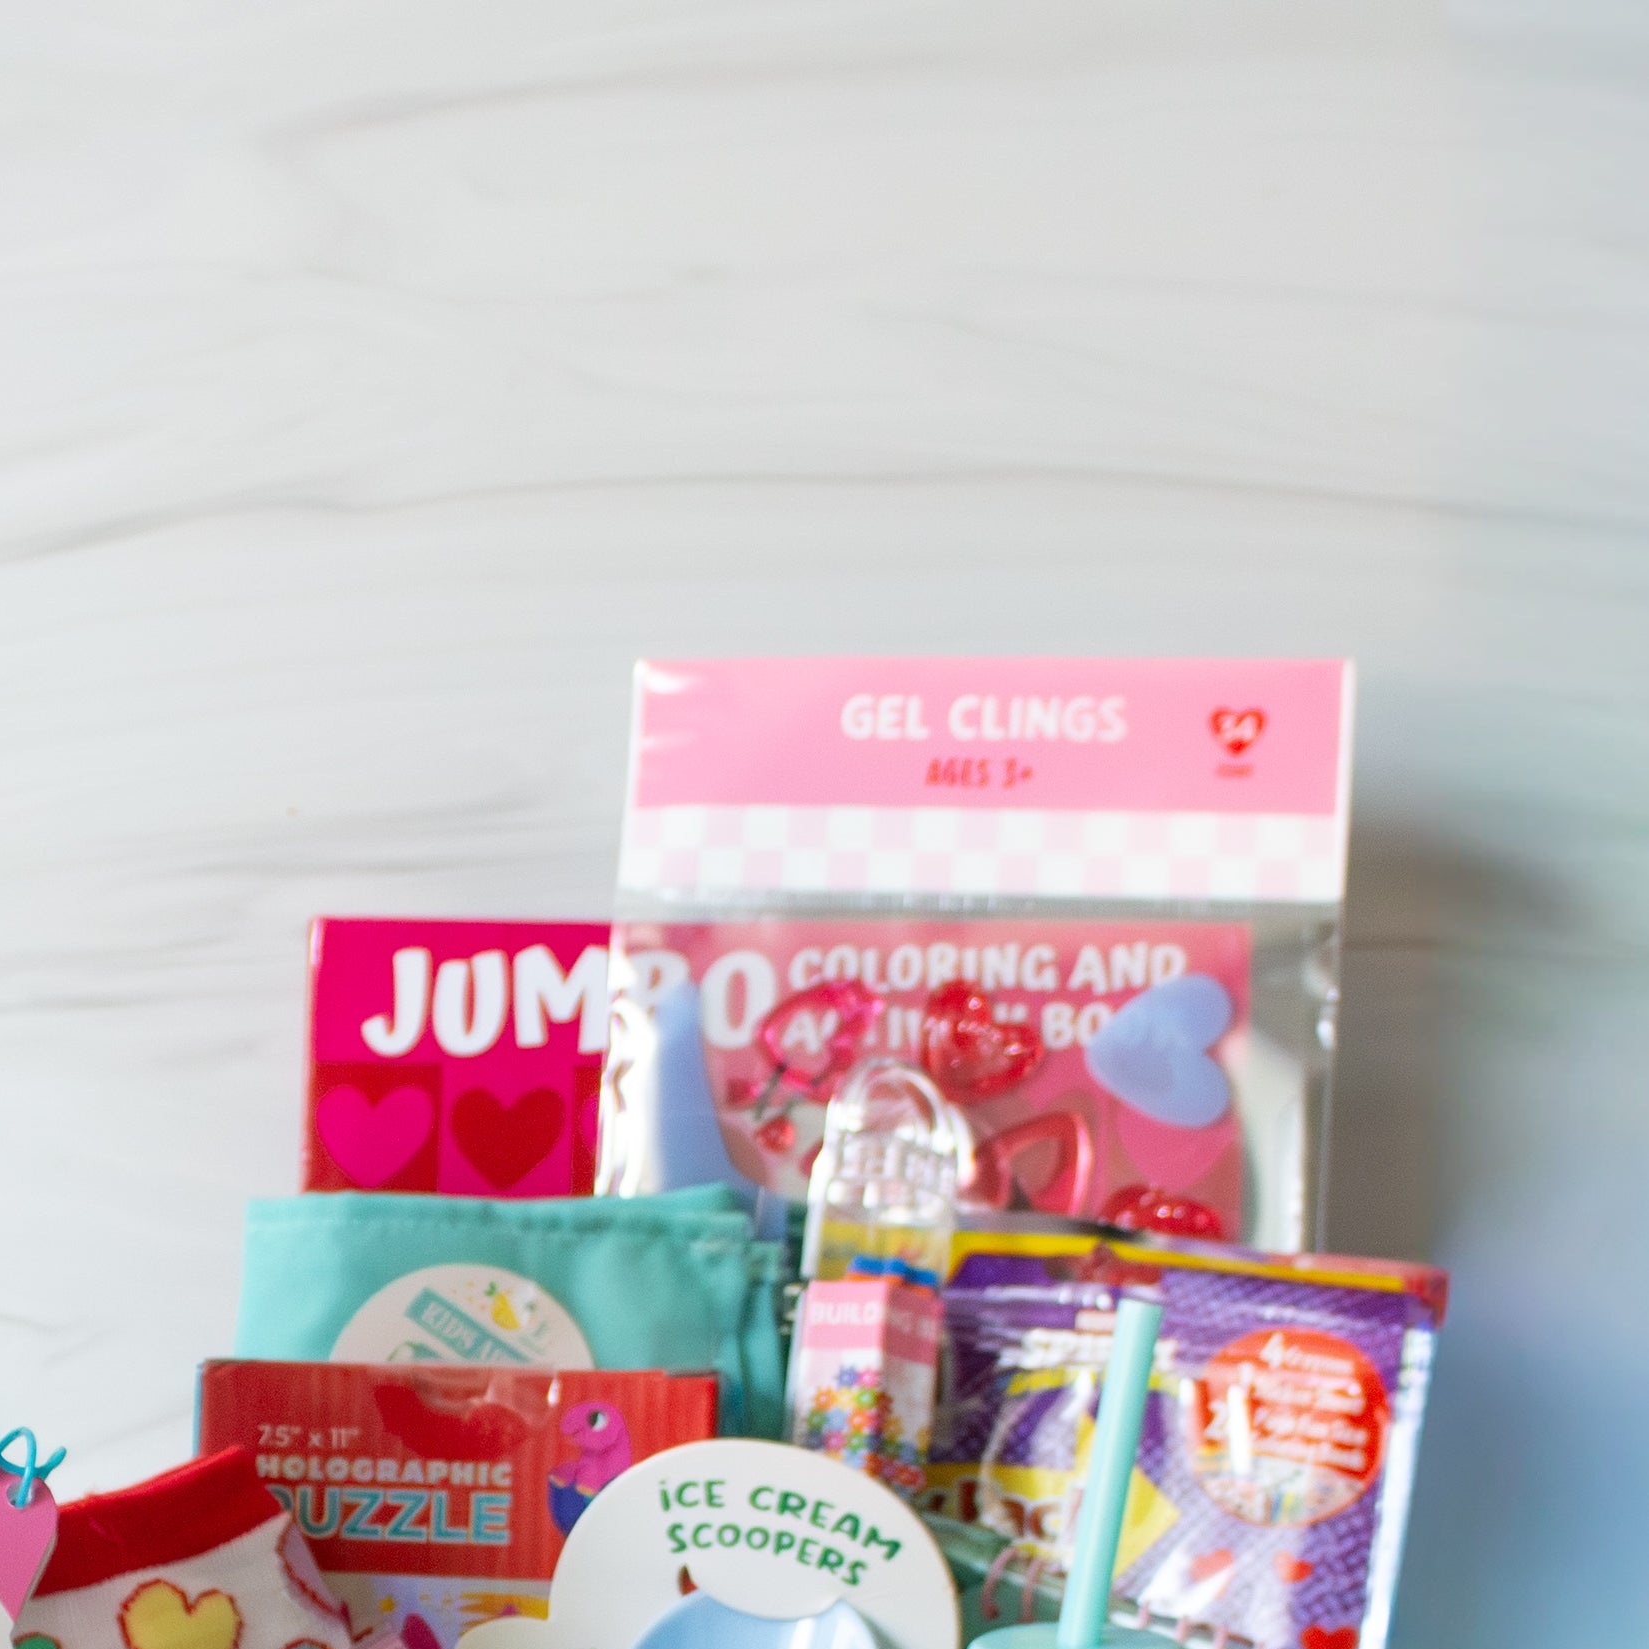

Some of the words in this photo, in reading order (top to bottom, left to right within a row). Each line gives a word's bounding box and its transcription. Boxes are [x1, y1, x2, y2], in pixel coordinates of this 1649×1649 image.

[841, 695, 929, 740] GEL
[948, 695, 1128, 742] CLINGS
[925, 757, 990, 788] AGES
[789, 941, 1059, 994] COLORING
[1067, 942, 1188, 995] AND
[811, 1301, 878, 1326] BUILD
[255, 1454, 512, 1488] HOLOGRAPHIC
[748, 1485, 902, 1561] CREAM
[666, 1522, 869, 1586] SCOOPERS
